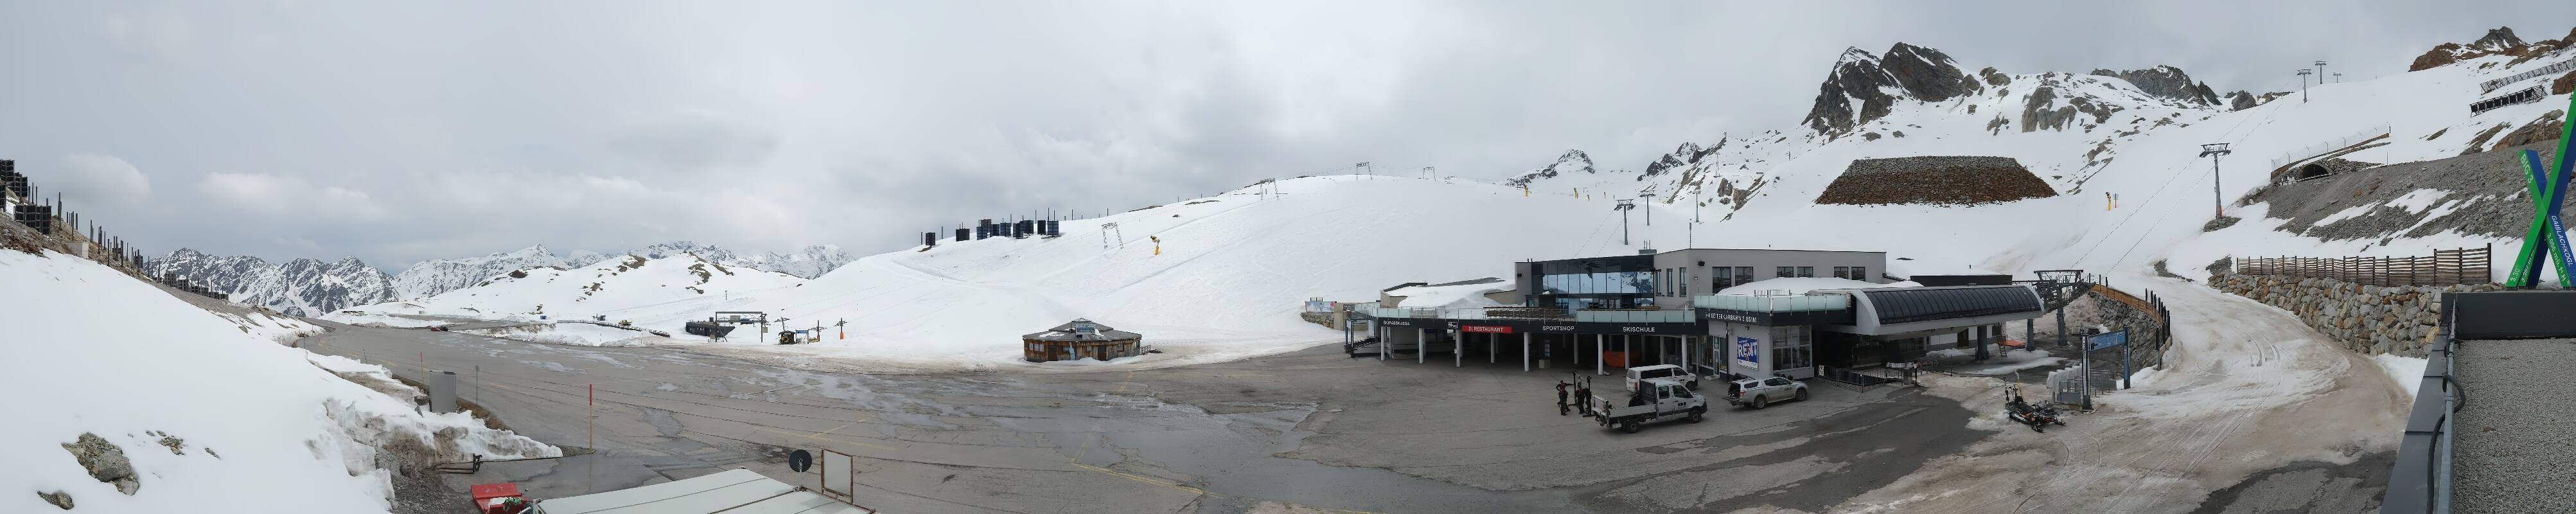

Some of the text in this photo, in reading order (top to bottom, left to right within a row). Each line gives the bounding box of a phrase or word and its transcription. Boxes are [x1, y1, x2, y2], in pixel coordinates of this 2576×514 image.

[2521, 153, 2534, 184] BIG 3
[2552, 215, 2573, 267] GAISLACHKOGL
[1711, 313, 1742, 321] SETERKARBAHN
[1738, 342, 1757, 357] RENT
